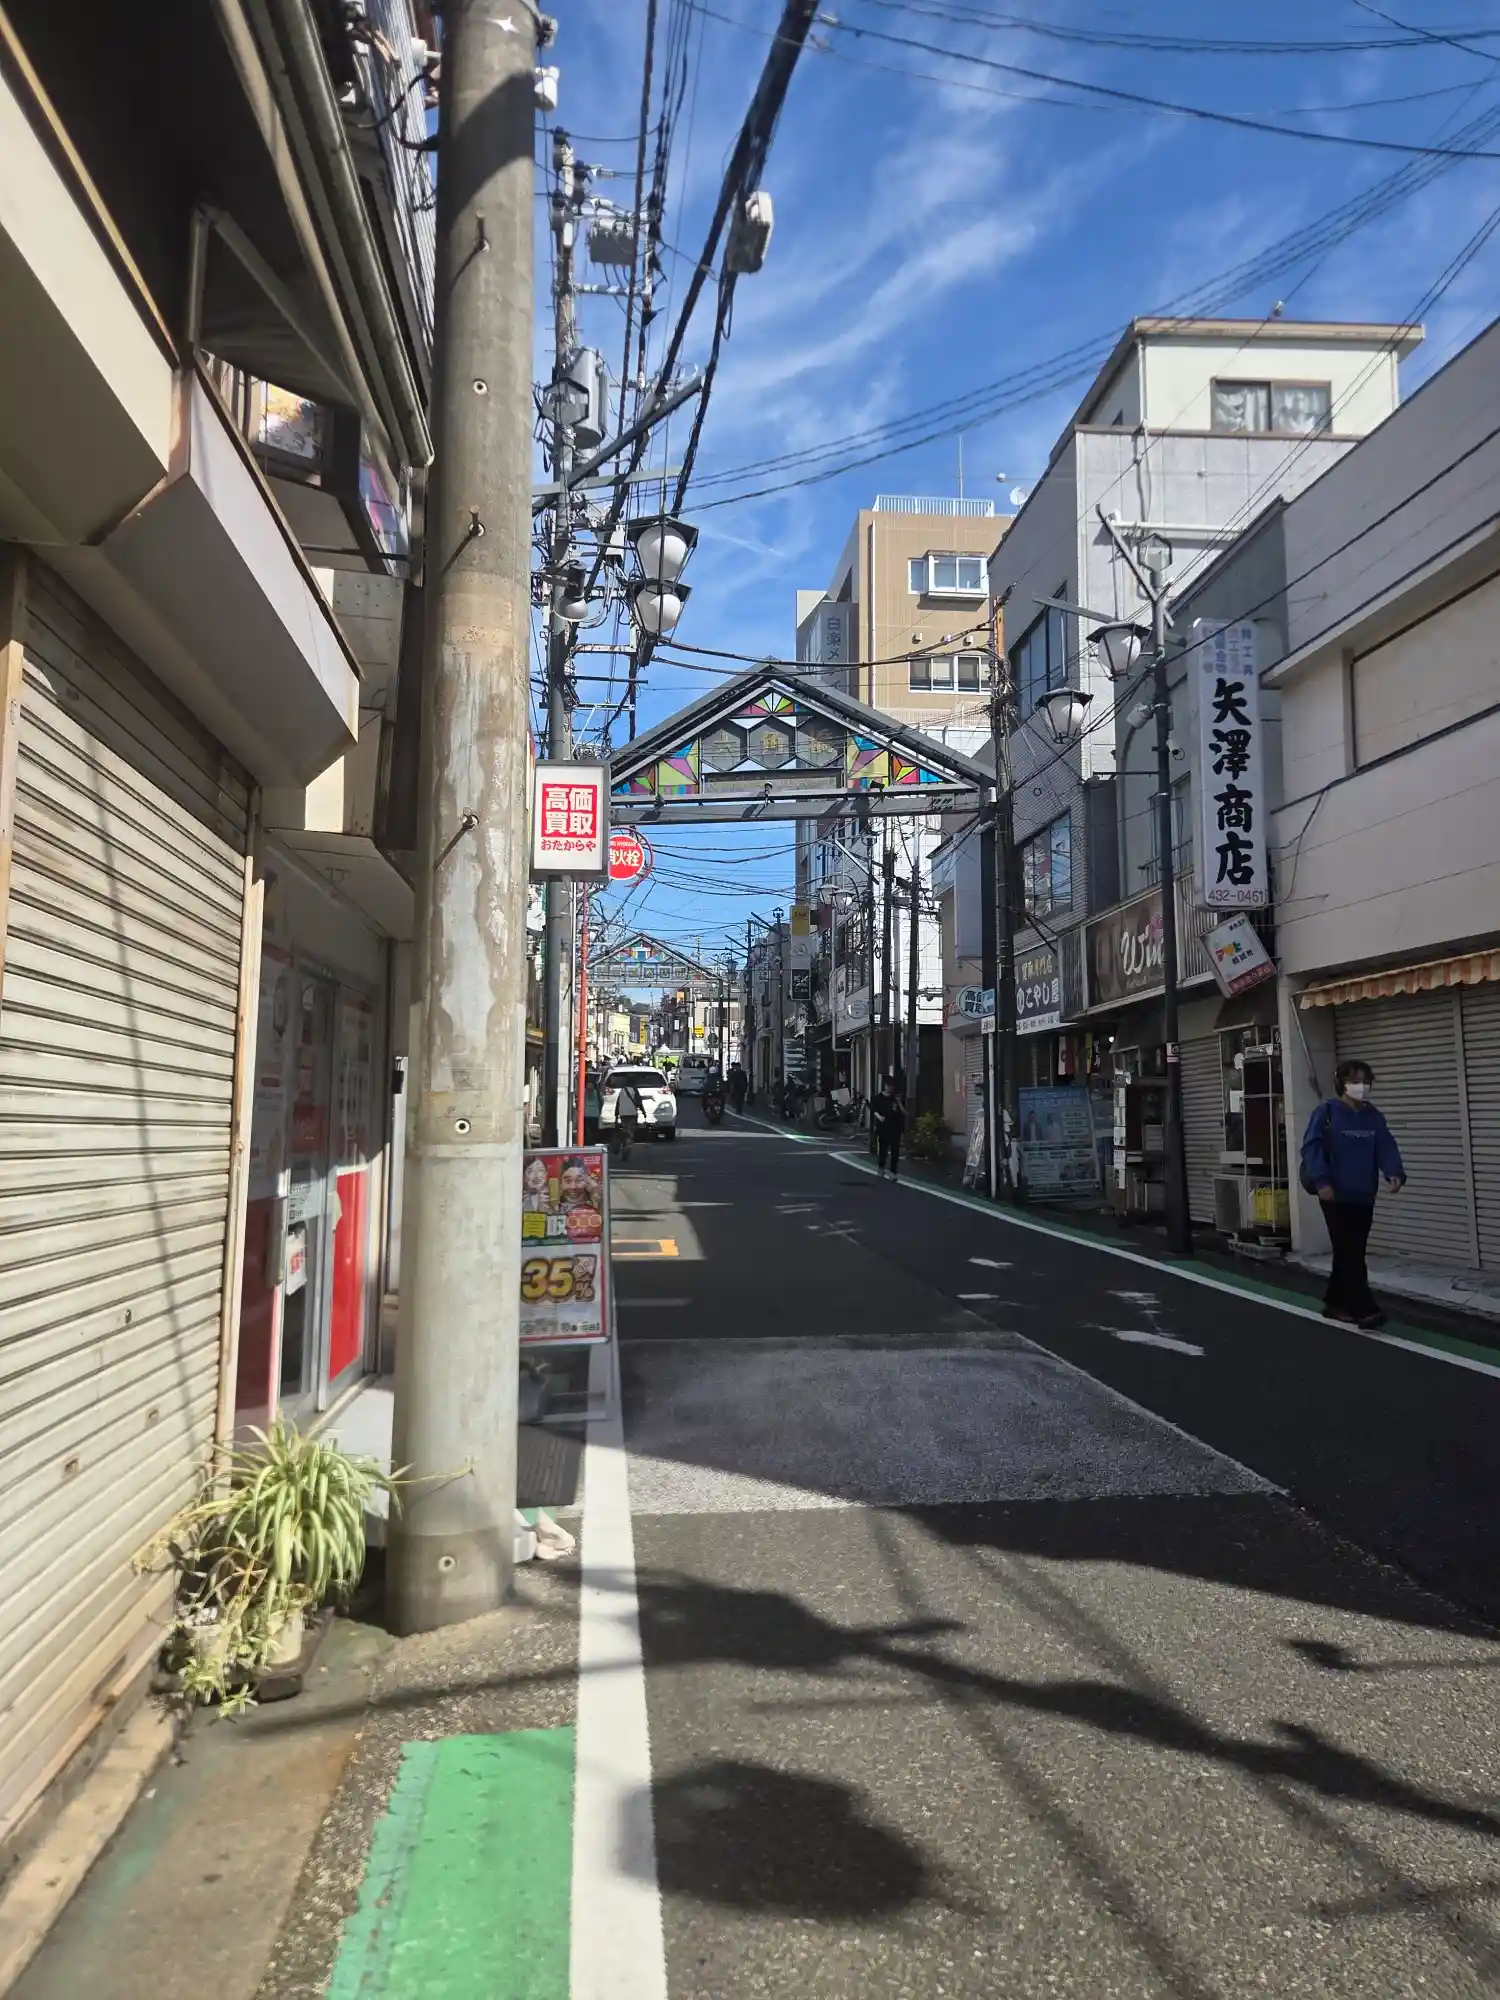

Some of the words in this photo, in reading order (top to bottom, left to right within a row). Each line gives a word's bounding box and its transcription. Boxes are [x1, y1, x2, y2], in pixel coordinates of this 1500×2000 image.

[1209, 677, 1255, 885] 矢澤商店
[545, 787, 594, 811] 高価
[545, 812, 593, 836] 買取
[540, 839, 596, 852] おたからや
